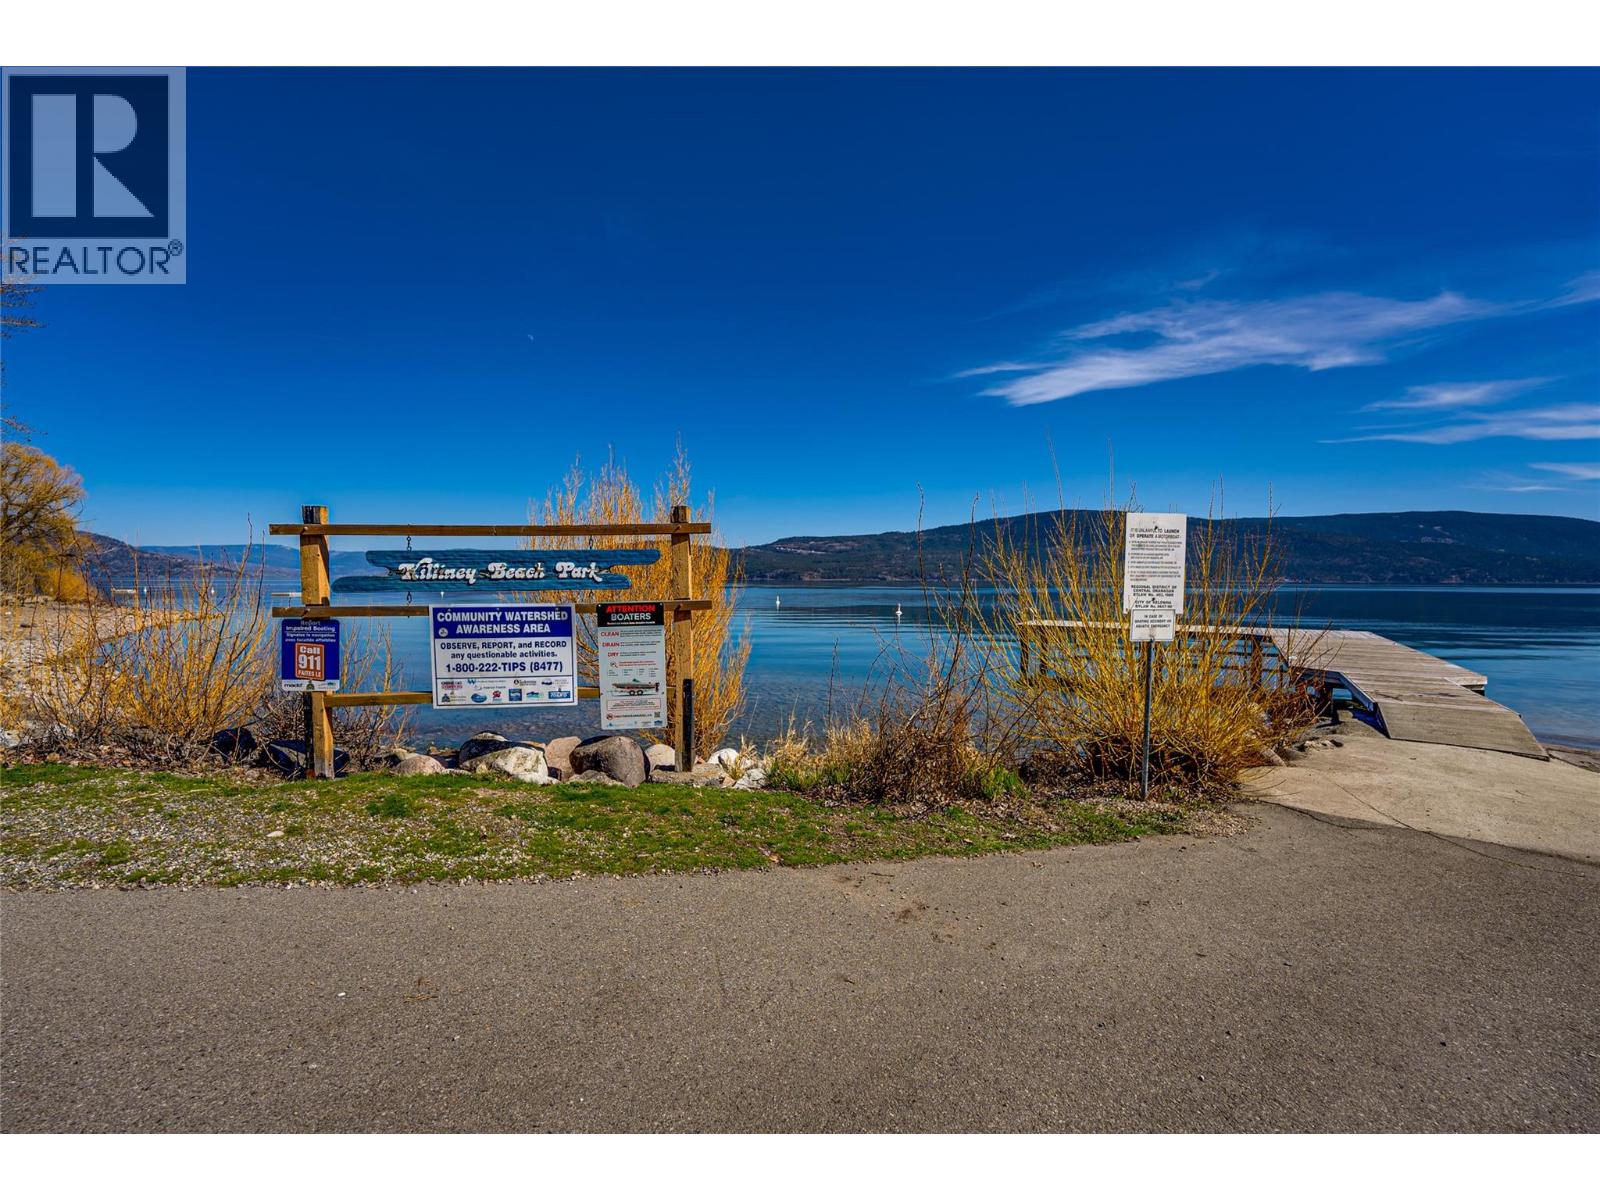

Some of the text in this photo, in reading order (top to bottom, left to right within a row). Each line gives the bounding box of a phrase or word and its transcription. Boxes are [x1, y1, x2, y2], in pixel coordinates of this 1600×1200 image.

[488, 561, 545, 580] Beach
[555, 561, 603, 582] Park
[606, 604, 656, 612] ATTENTION
[437, 611, 568, 622] COMMUNITY WATERSHED
[455, 623, 551, 634] AWARENESS AREA
[300, 646, 320, 654] Call
[440, 640, 567, 650] OBSERVE, REPORT, and RECORD
[451, 650, 558, 660] any questionable activities.
[298, 654, 321, 670] 911
[446, 661, 563, 673] 1-800-222-TIPS (8477)
